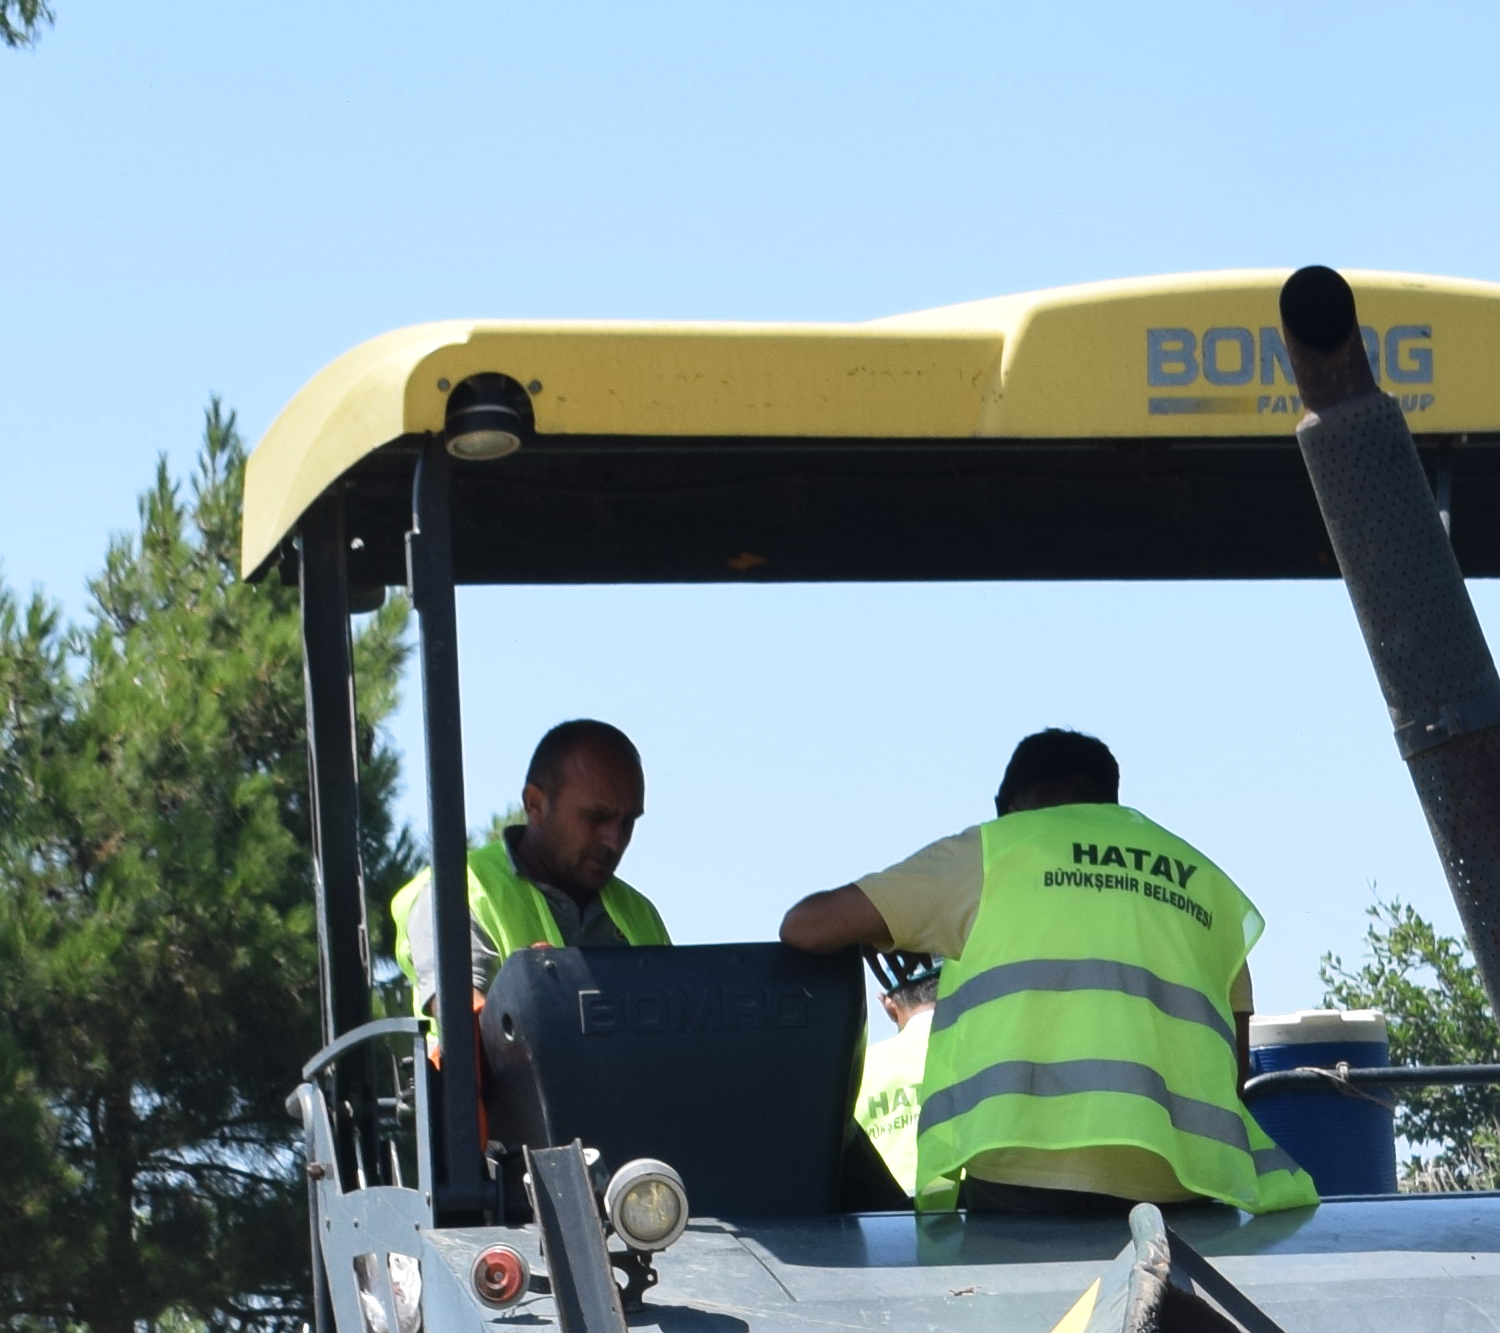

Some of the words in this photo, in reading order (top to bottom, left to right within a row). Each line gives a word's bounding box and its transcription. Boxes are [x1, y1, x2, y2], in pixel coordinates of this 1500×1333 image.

[1072, 842, 1198, 890] HATAY
[1044, 867, 1139, 893] BÜYÜKŞEHİR
[1143, 881, 1213, 931] BELEDİYESİ
